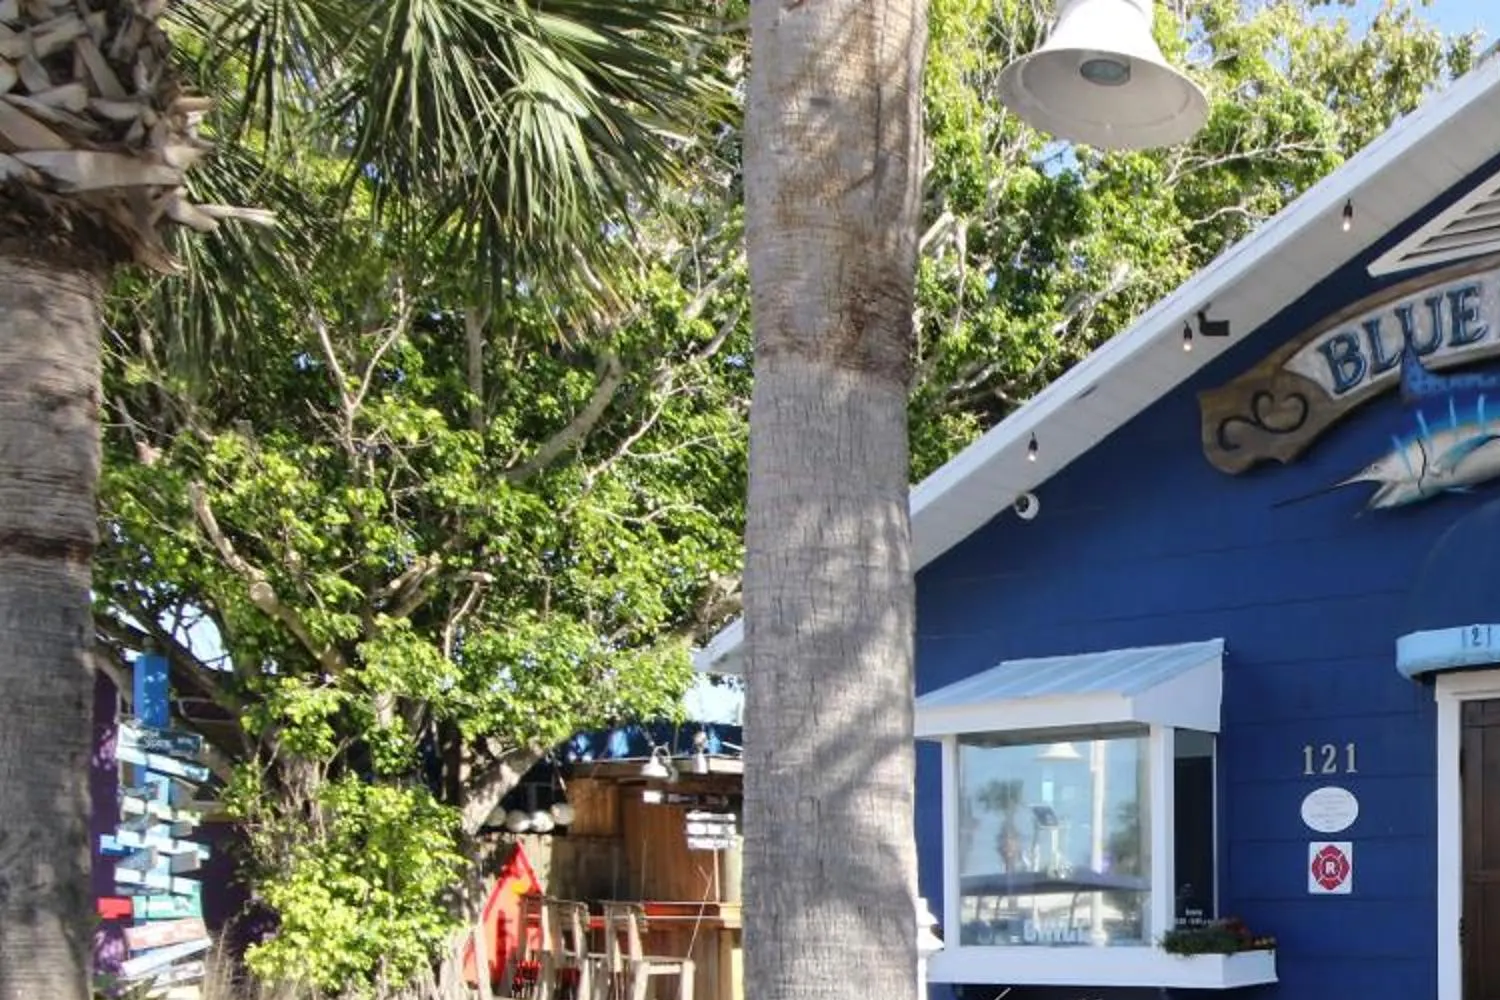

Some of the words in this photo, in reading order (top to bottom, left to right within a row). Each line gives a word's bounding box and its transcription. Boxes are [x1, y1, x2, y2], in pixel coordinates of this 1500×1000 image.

[1317, 281, 1489, 394] BLUE
[1303, 742, 1359, 775] 121
[1325, 861, 1336, 874] R
